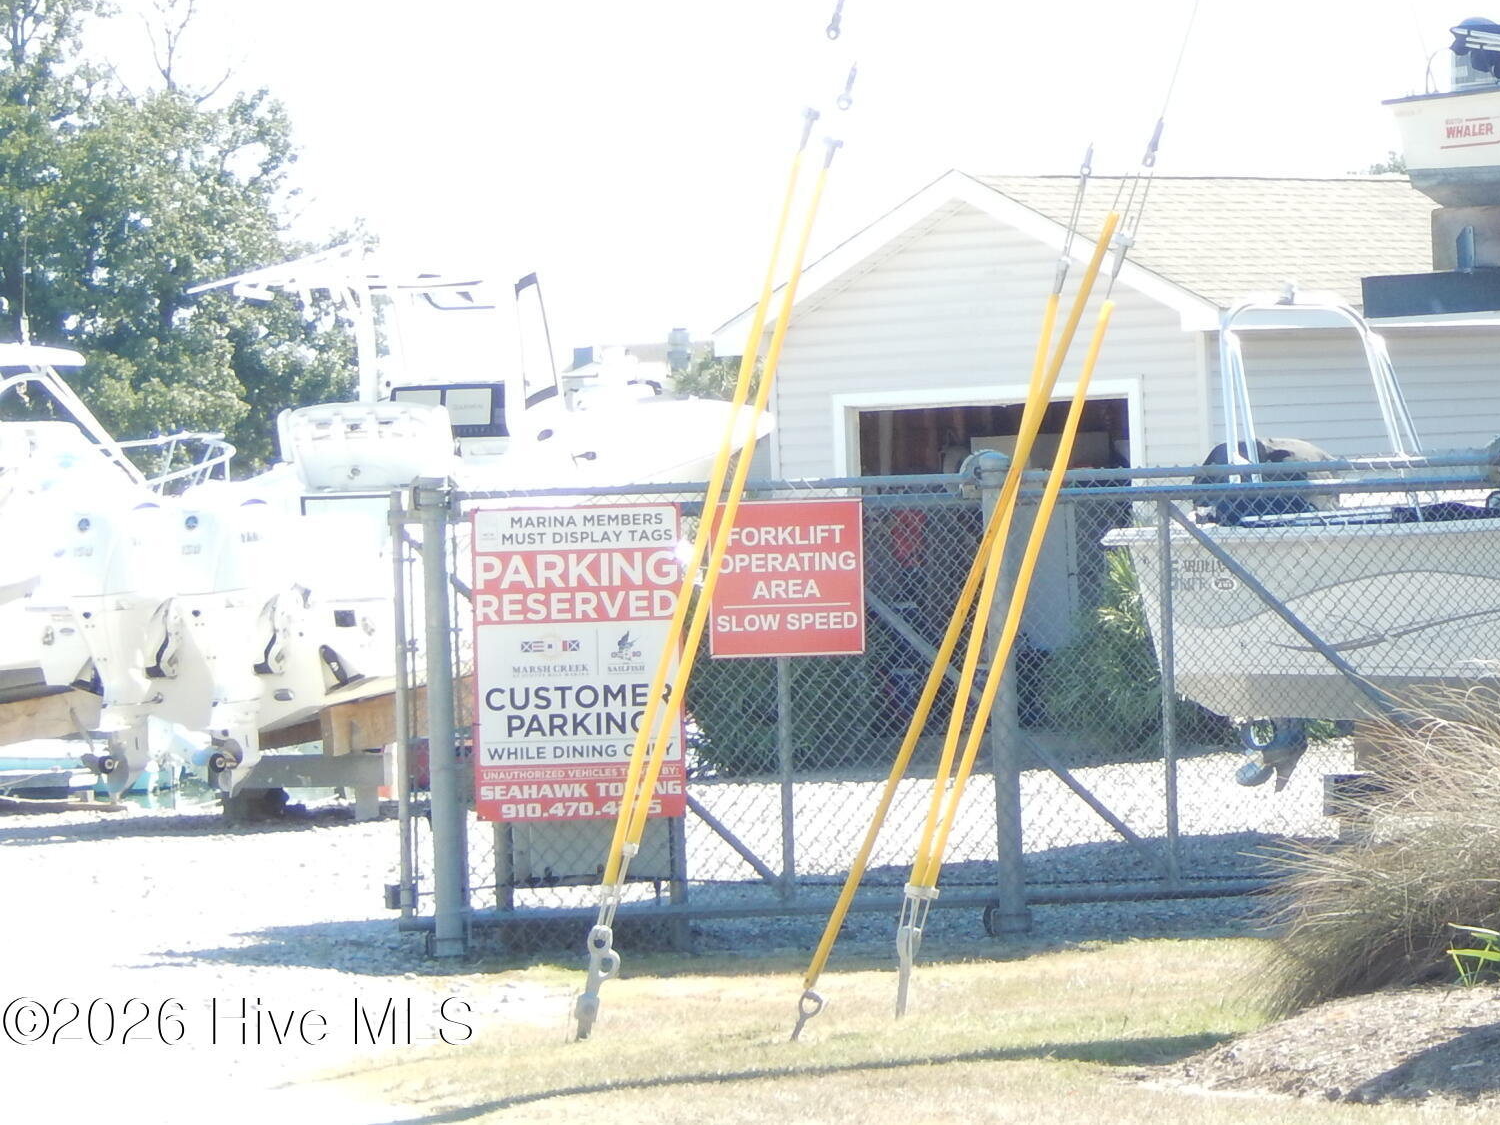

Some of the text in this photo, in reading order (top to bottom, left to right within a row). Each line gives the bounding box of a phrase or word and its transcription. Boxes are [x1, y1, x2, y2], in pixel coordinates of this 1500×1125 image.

[1445, 122, 1495, 139] WHALER
[510, 512, 663, 529] MARINA MEMBERS
[501, 528, 673, 545] MUST DISPLAY TAGS
[726, 524, 845, 547] FORKLIFT
[475, 550, 678, 590] PARKING
[719, 550, 857, 574] OPERATING
[752, 578, 821, 600] AREA
[476, 589, 678, 623] RESERVED
[716, 611, 858, 633] SLOW SPEED
[511, 663, 589, 674] MARSH CREEK
[487, 745, 547, 761] WHILE
[553, 744, 617, 760] DINING
[482, 769, 565, 780] UNAUTHORIZED
[568, 767, 621, 779] VEHICLES
[661, 766, 680, 775] BY:
[480, 780, 682, 801] SEAHAWK TONG
[501, 799, 663, 819] 910.470.45
